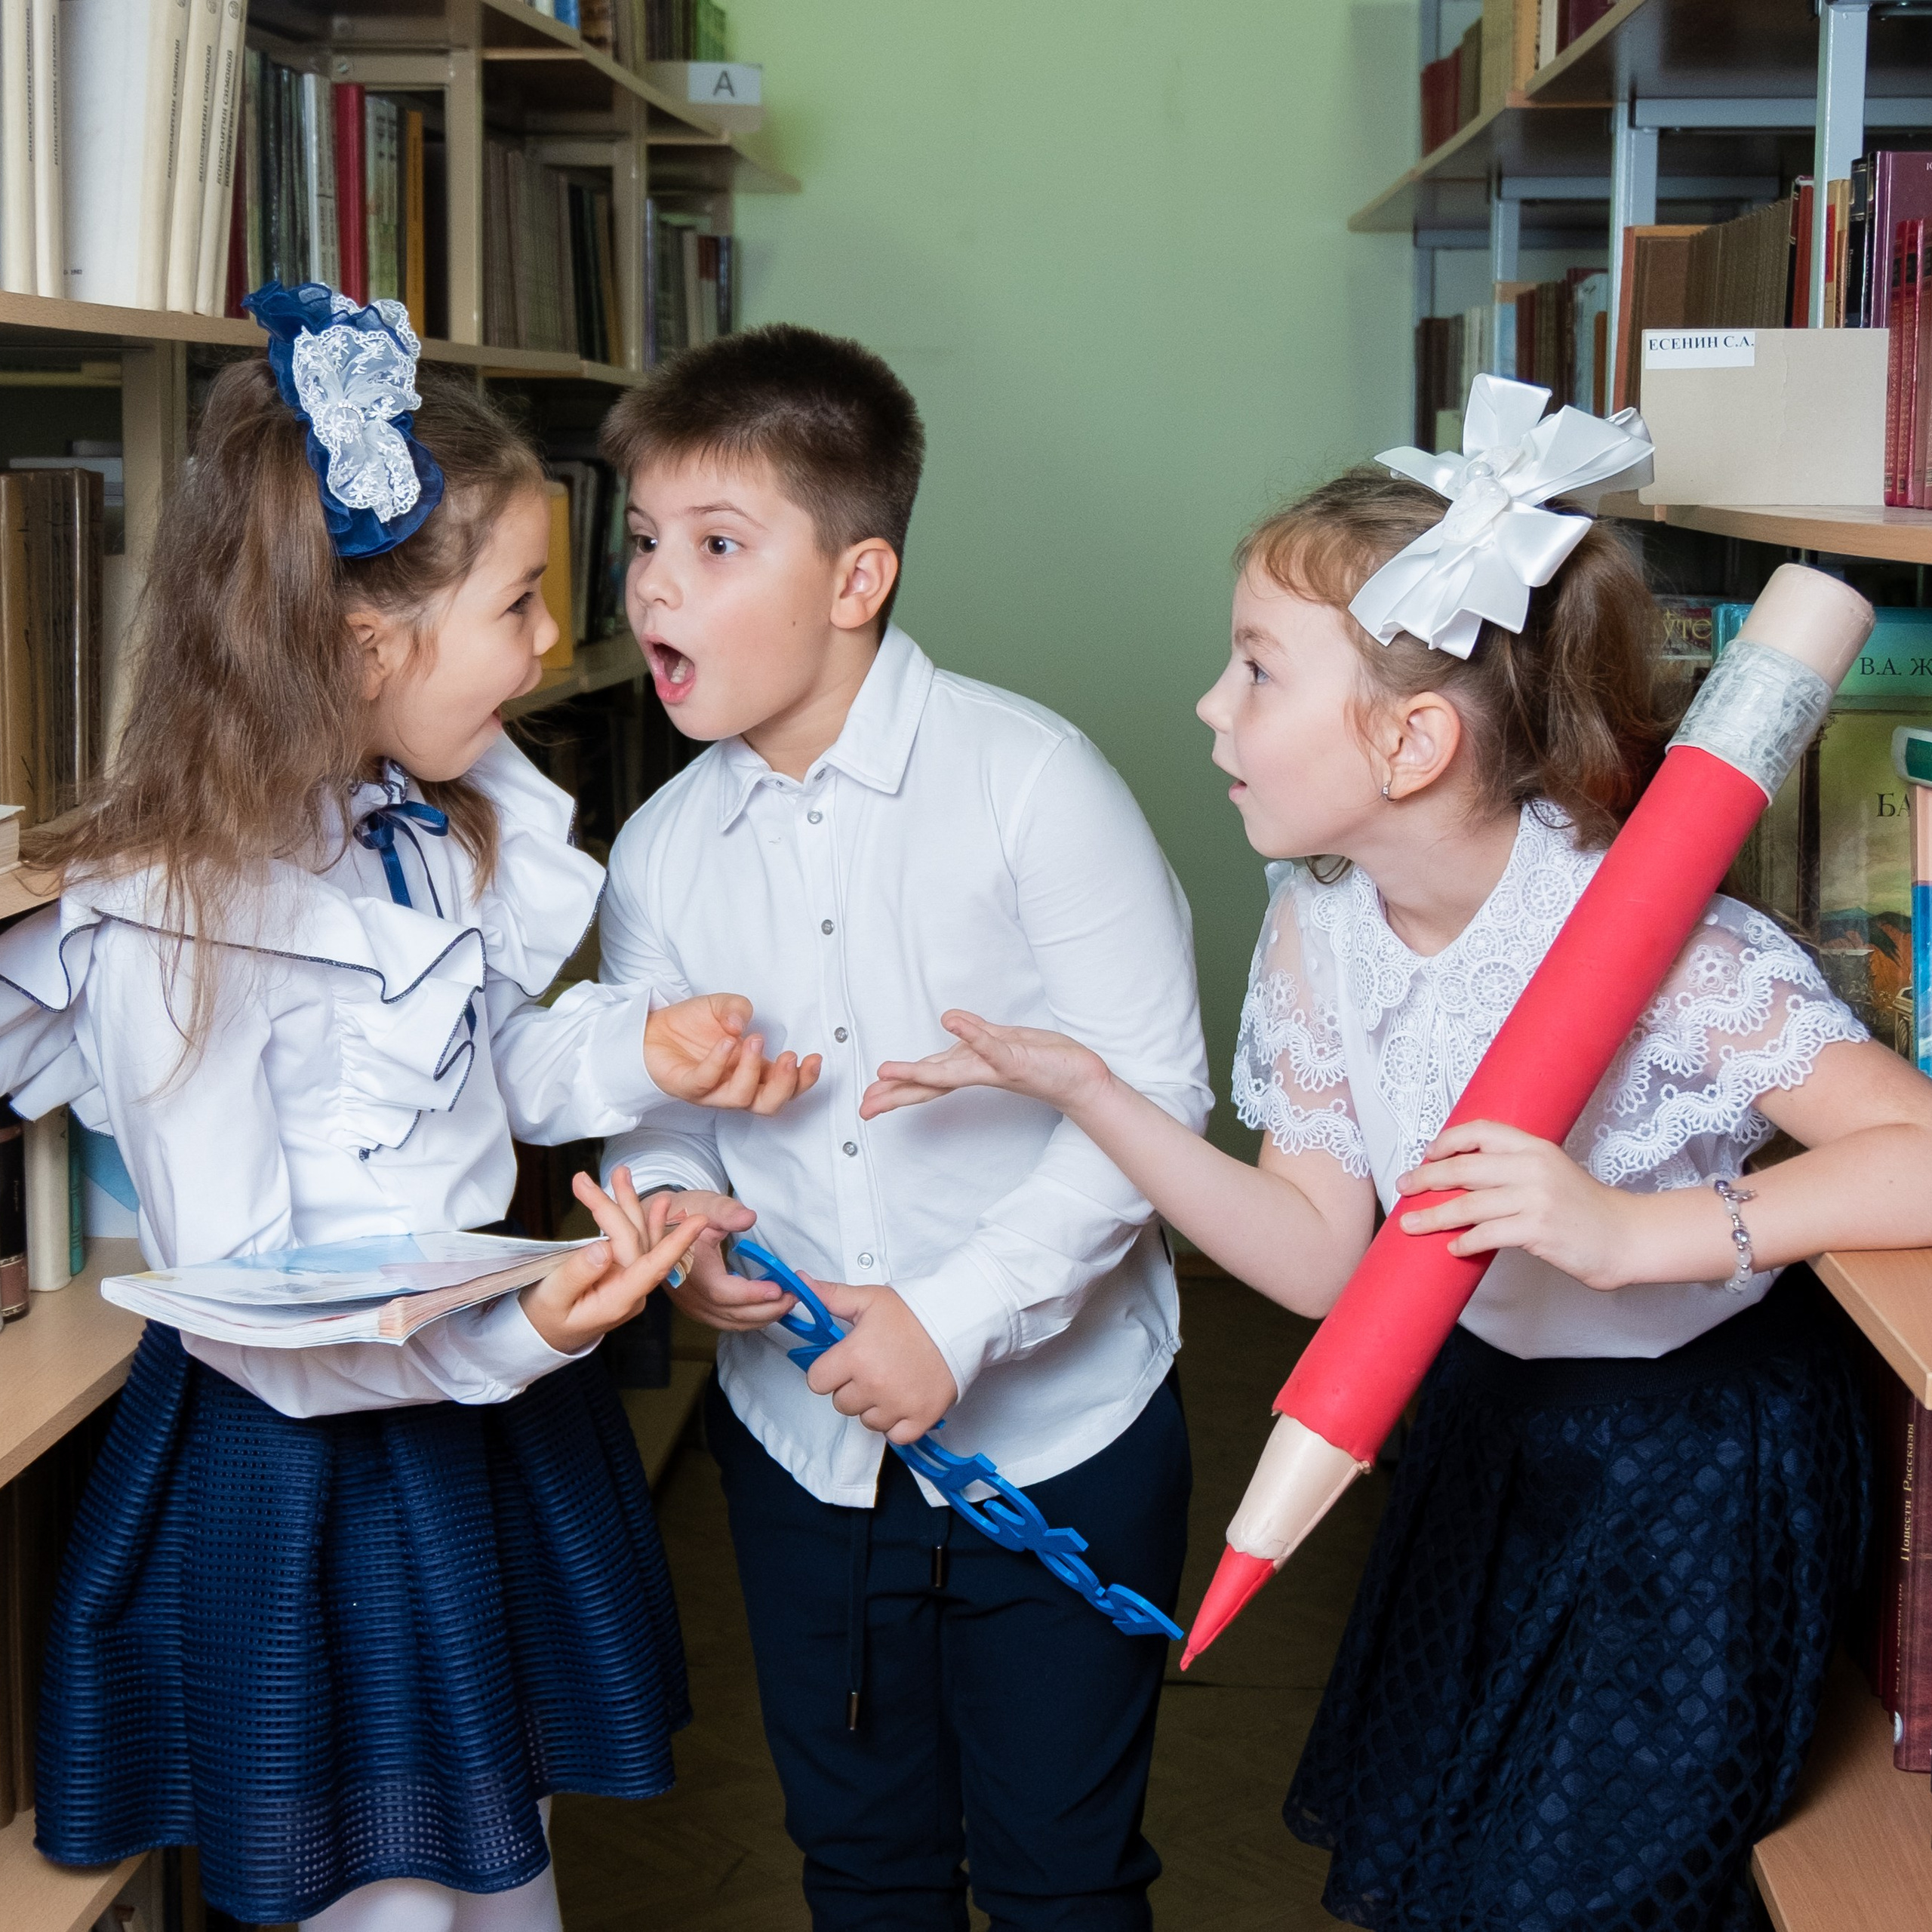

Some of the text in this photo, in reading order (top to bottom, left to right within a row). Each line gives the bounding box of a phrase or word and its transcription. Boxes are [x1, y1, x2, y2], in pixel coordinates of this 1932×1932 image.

[216, 49, 232, 184] КОНСТАНТИН СИМОНОВ
[1649, 336, 1754, 351] ЕСЕНИН С.А.
[1860, 657, 1902, 675] В.А.
[1900, 1423, 1914, 1561] Повести Рассказы
